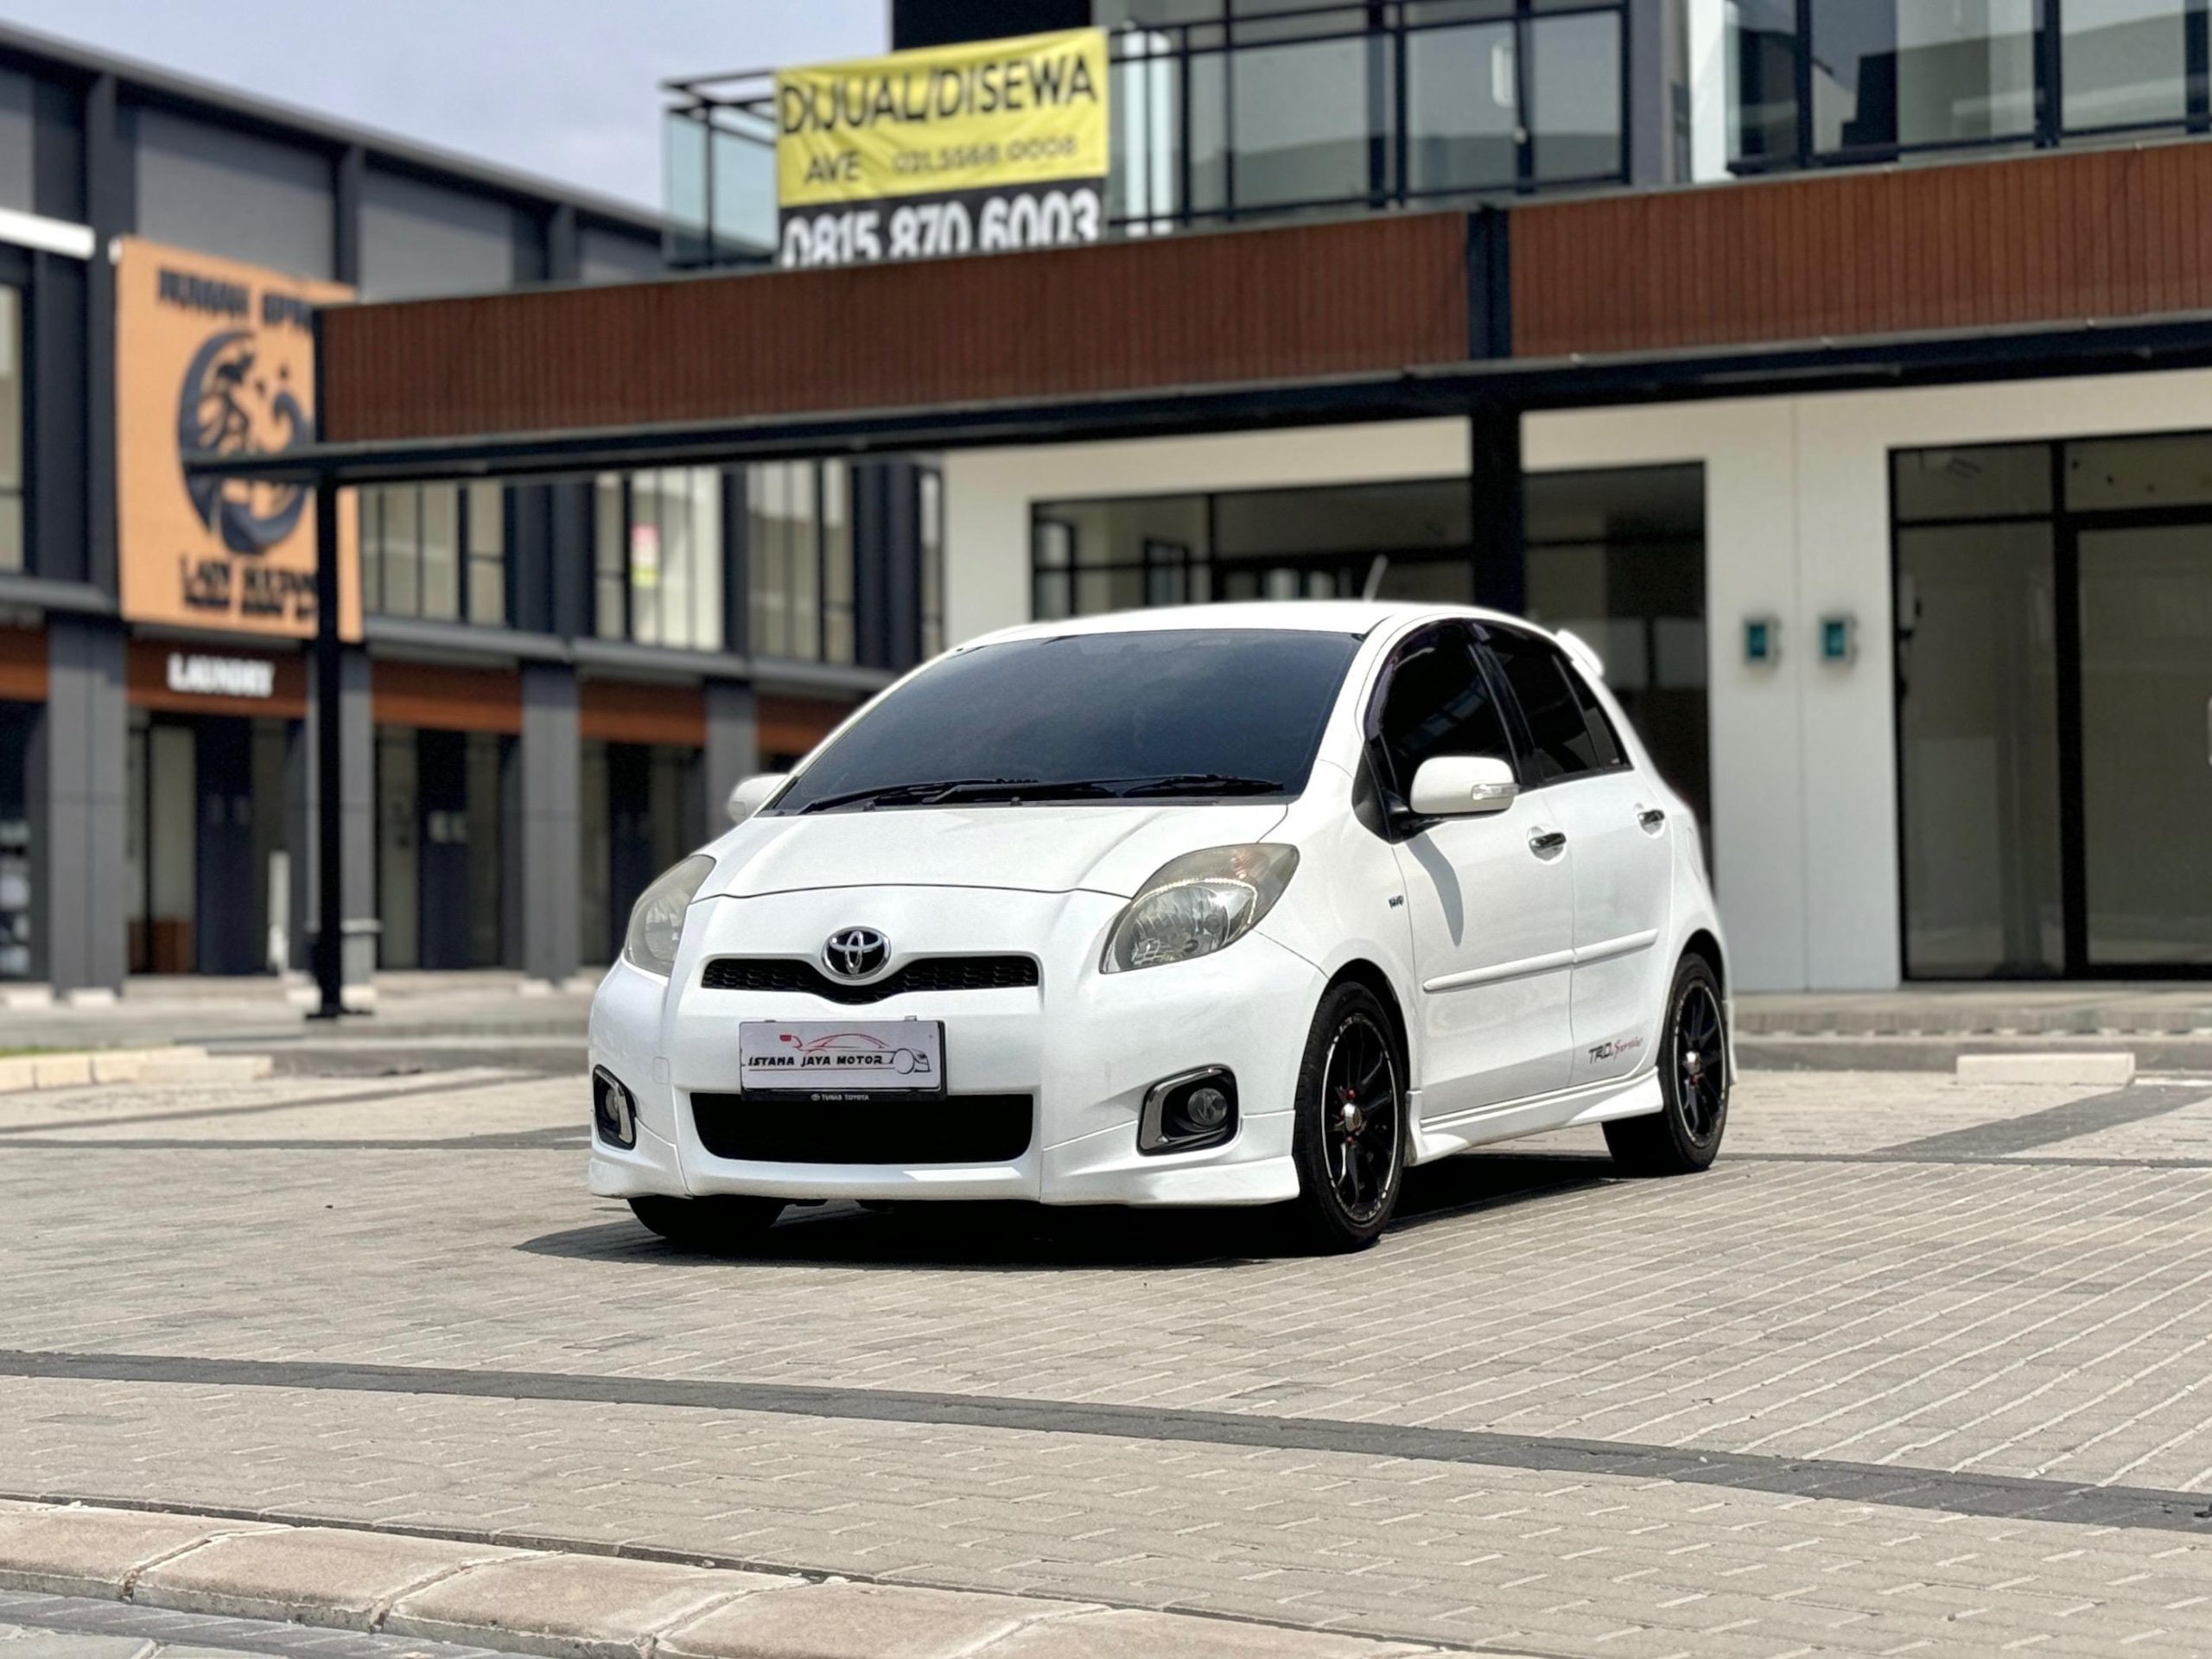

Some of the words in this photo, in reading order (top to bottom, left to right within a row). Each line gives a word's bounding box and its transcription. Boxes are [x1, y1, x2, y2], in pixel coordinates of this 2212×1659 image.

[782, 54, 1098, 136] DIJUAL/DISEWA
[782, 209, 881, 269] 0815
[888, 200, 973, 260] 870
[978, 188, 1101, 252] 6003
[748, 1056, 795, 1066] ISTANA
[800, 1055, 831, 1067] JAYA
[836, 1055, 883, 1065] MOTOR
[1589, 1041, 1611, 1064] TRD
